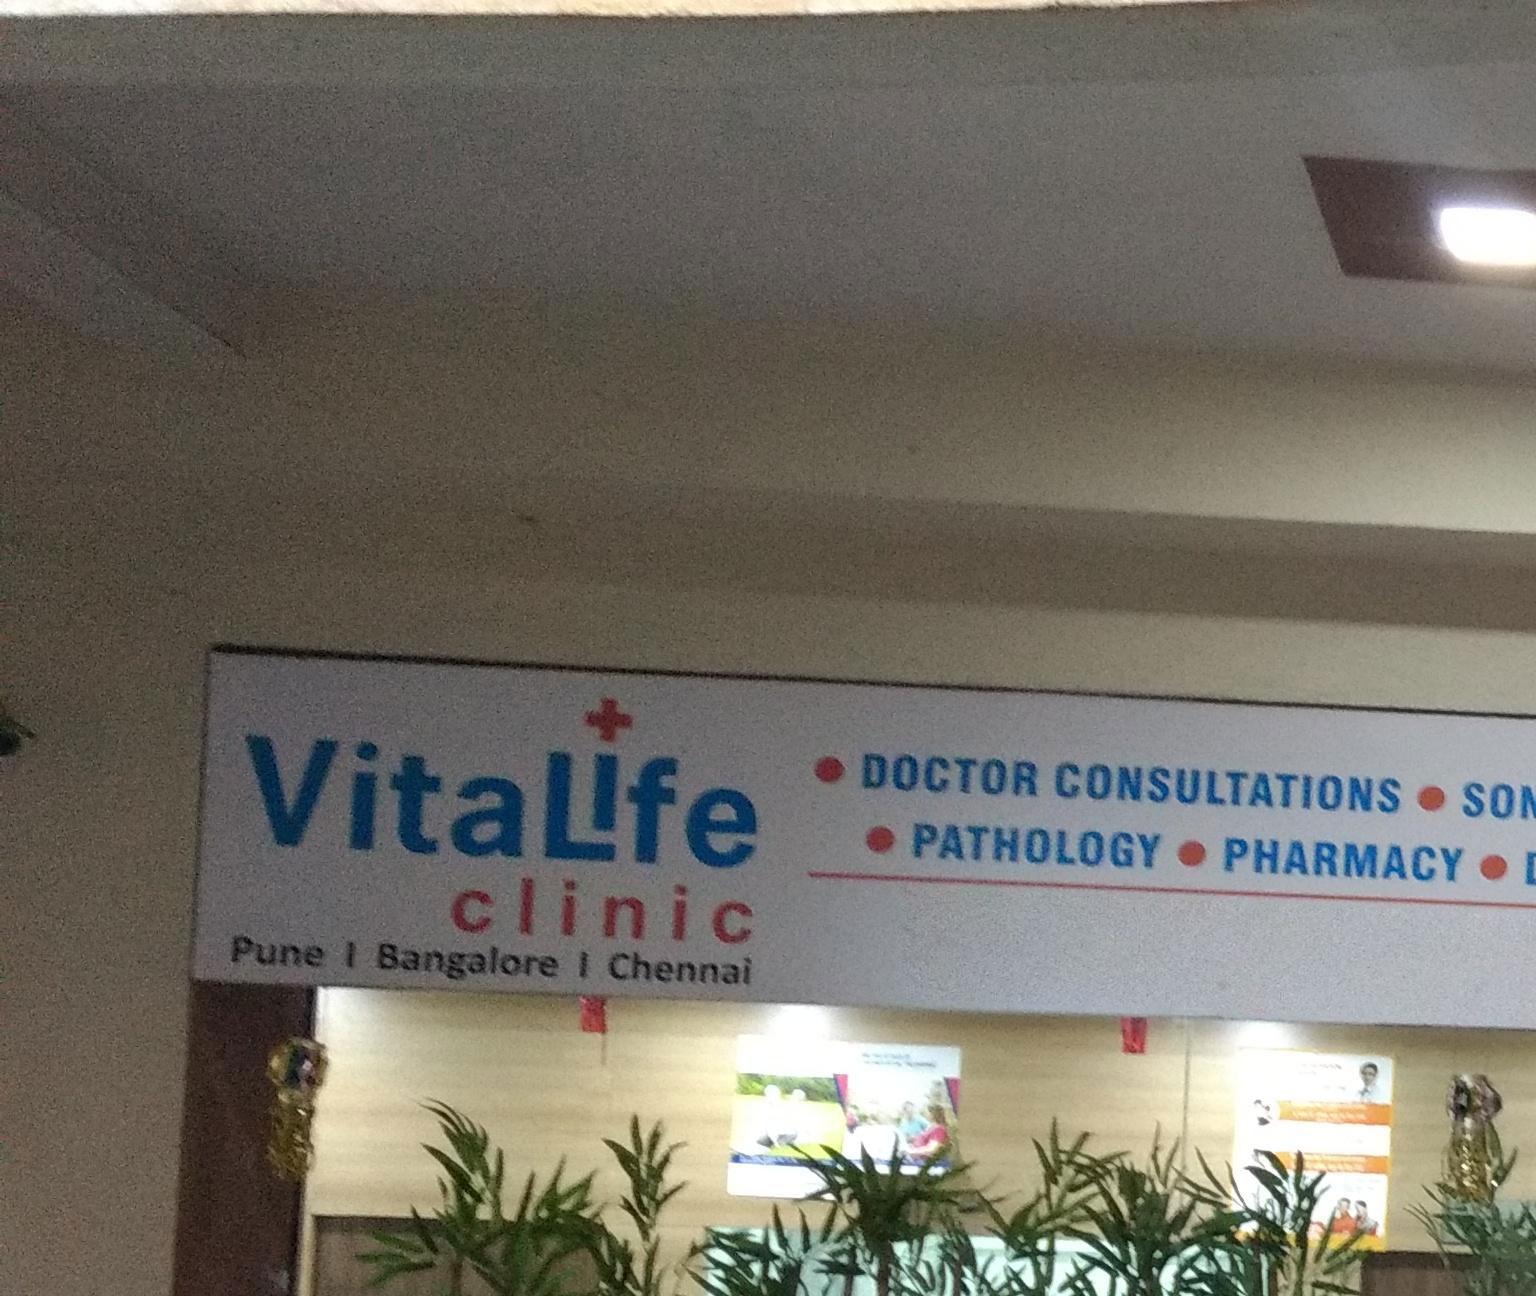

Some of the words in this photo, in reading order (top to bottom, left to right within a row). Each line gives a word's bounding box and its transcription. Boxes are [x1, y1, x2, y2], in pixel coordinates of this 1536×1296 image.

[245, 735, 758, 868] VitaLife
[862, 753, 1038, 798] DOCTOR
[1055, 762, 1400, 813] CONSULTATIONS
[912, 823, 1161, 868] PATHOLOGY
[1224, 837, 1463, 881] PHARMACY
[452, 879, 753, 944] clinic
[231, 935, 324, 968] Pune
[376, 944, 558, 981] Bangalore
[608, 952, 752, 986] Chennai
